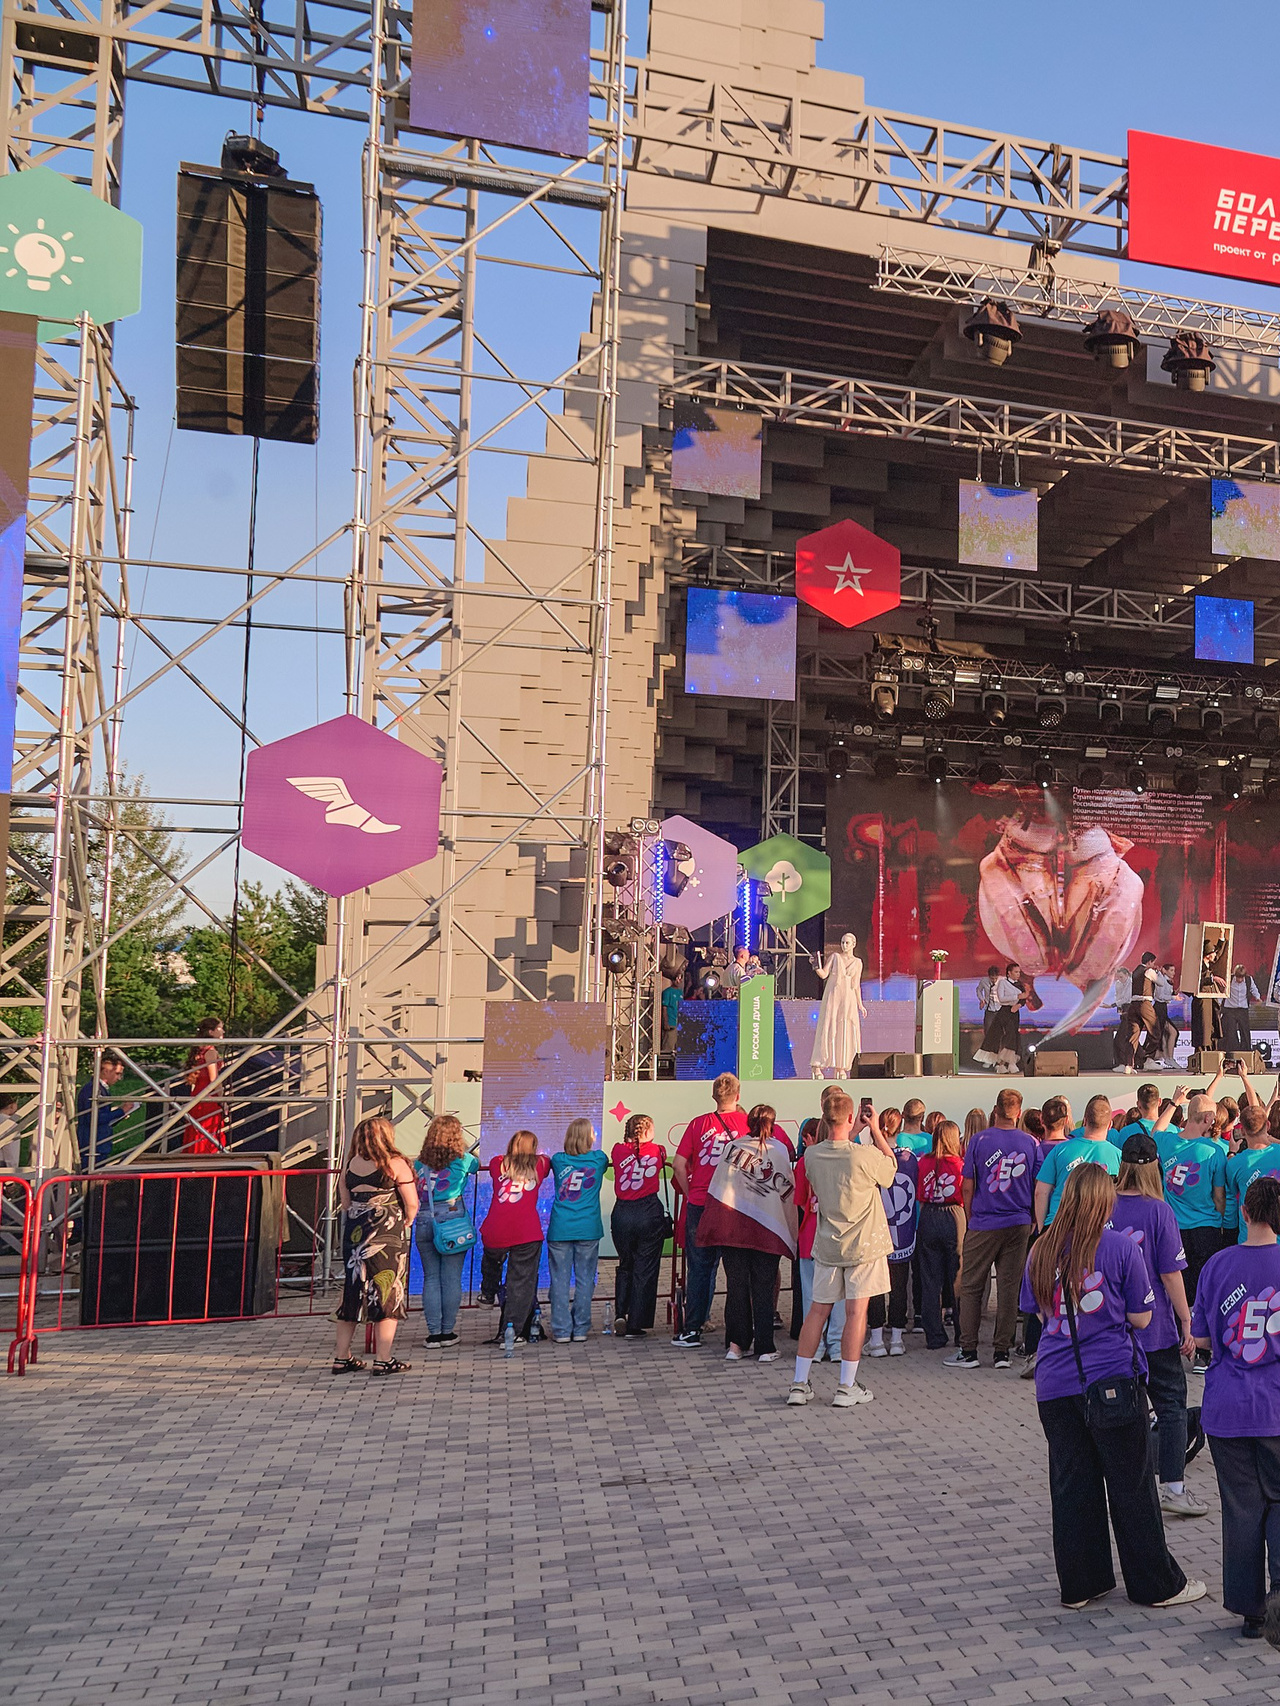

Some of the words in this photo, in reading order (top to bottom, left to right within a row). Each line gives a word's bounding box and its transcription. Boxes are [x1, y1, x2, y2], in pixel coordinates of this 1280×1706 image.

[1213, 243, 1251, 257] проект
[1253, 250, 1266, 260] от
[752, 995, 761, 1021] ДУША
[933, 1011, 942, 1044] СЕМЬЯ
[751, 1022, 760, 1060] РУССКАЯ
[710, 1135, 728, 1156] 5
[999, 1158, 1014, 1179] 5
[1172, 1165, 1189, 1186] 5
[568, 1172, 585, 1191] 5
[1219, 1283, 1248, 1316] СЕЗОН
[1242, 1301, 1269, 1339] 5
